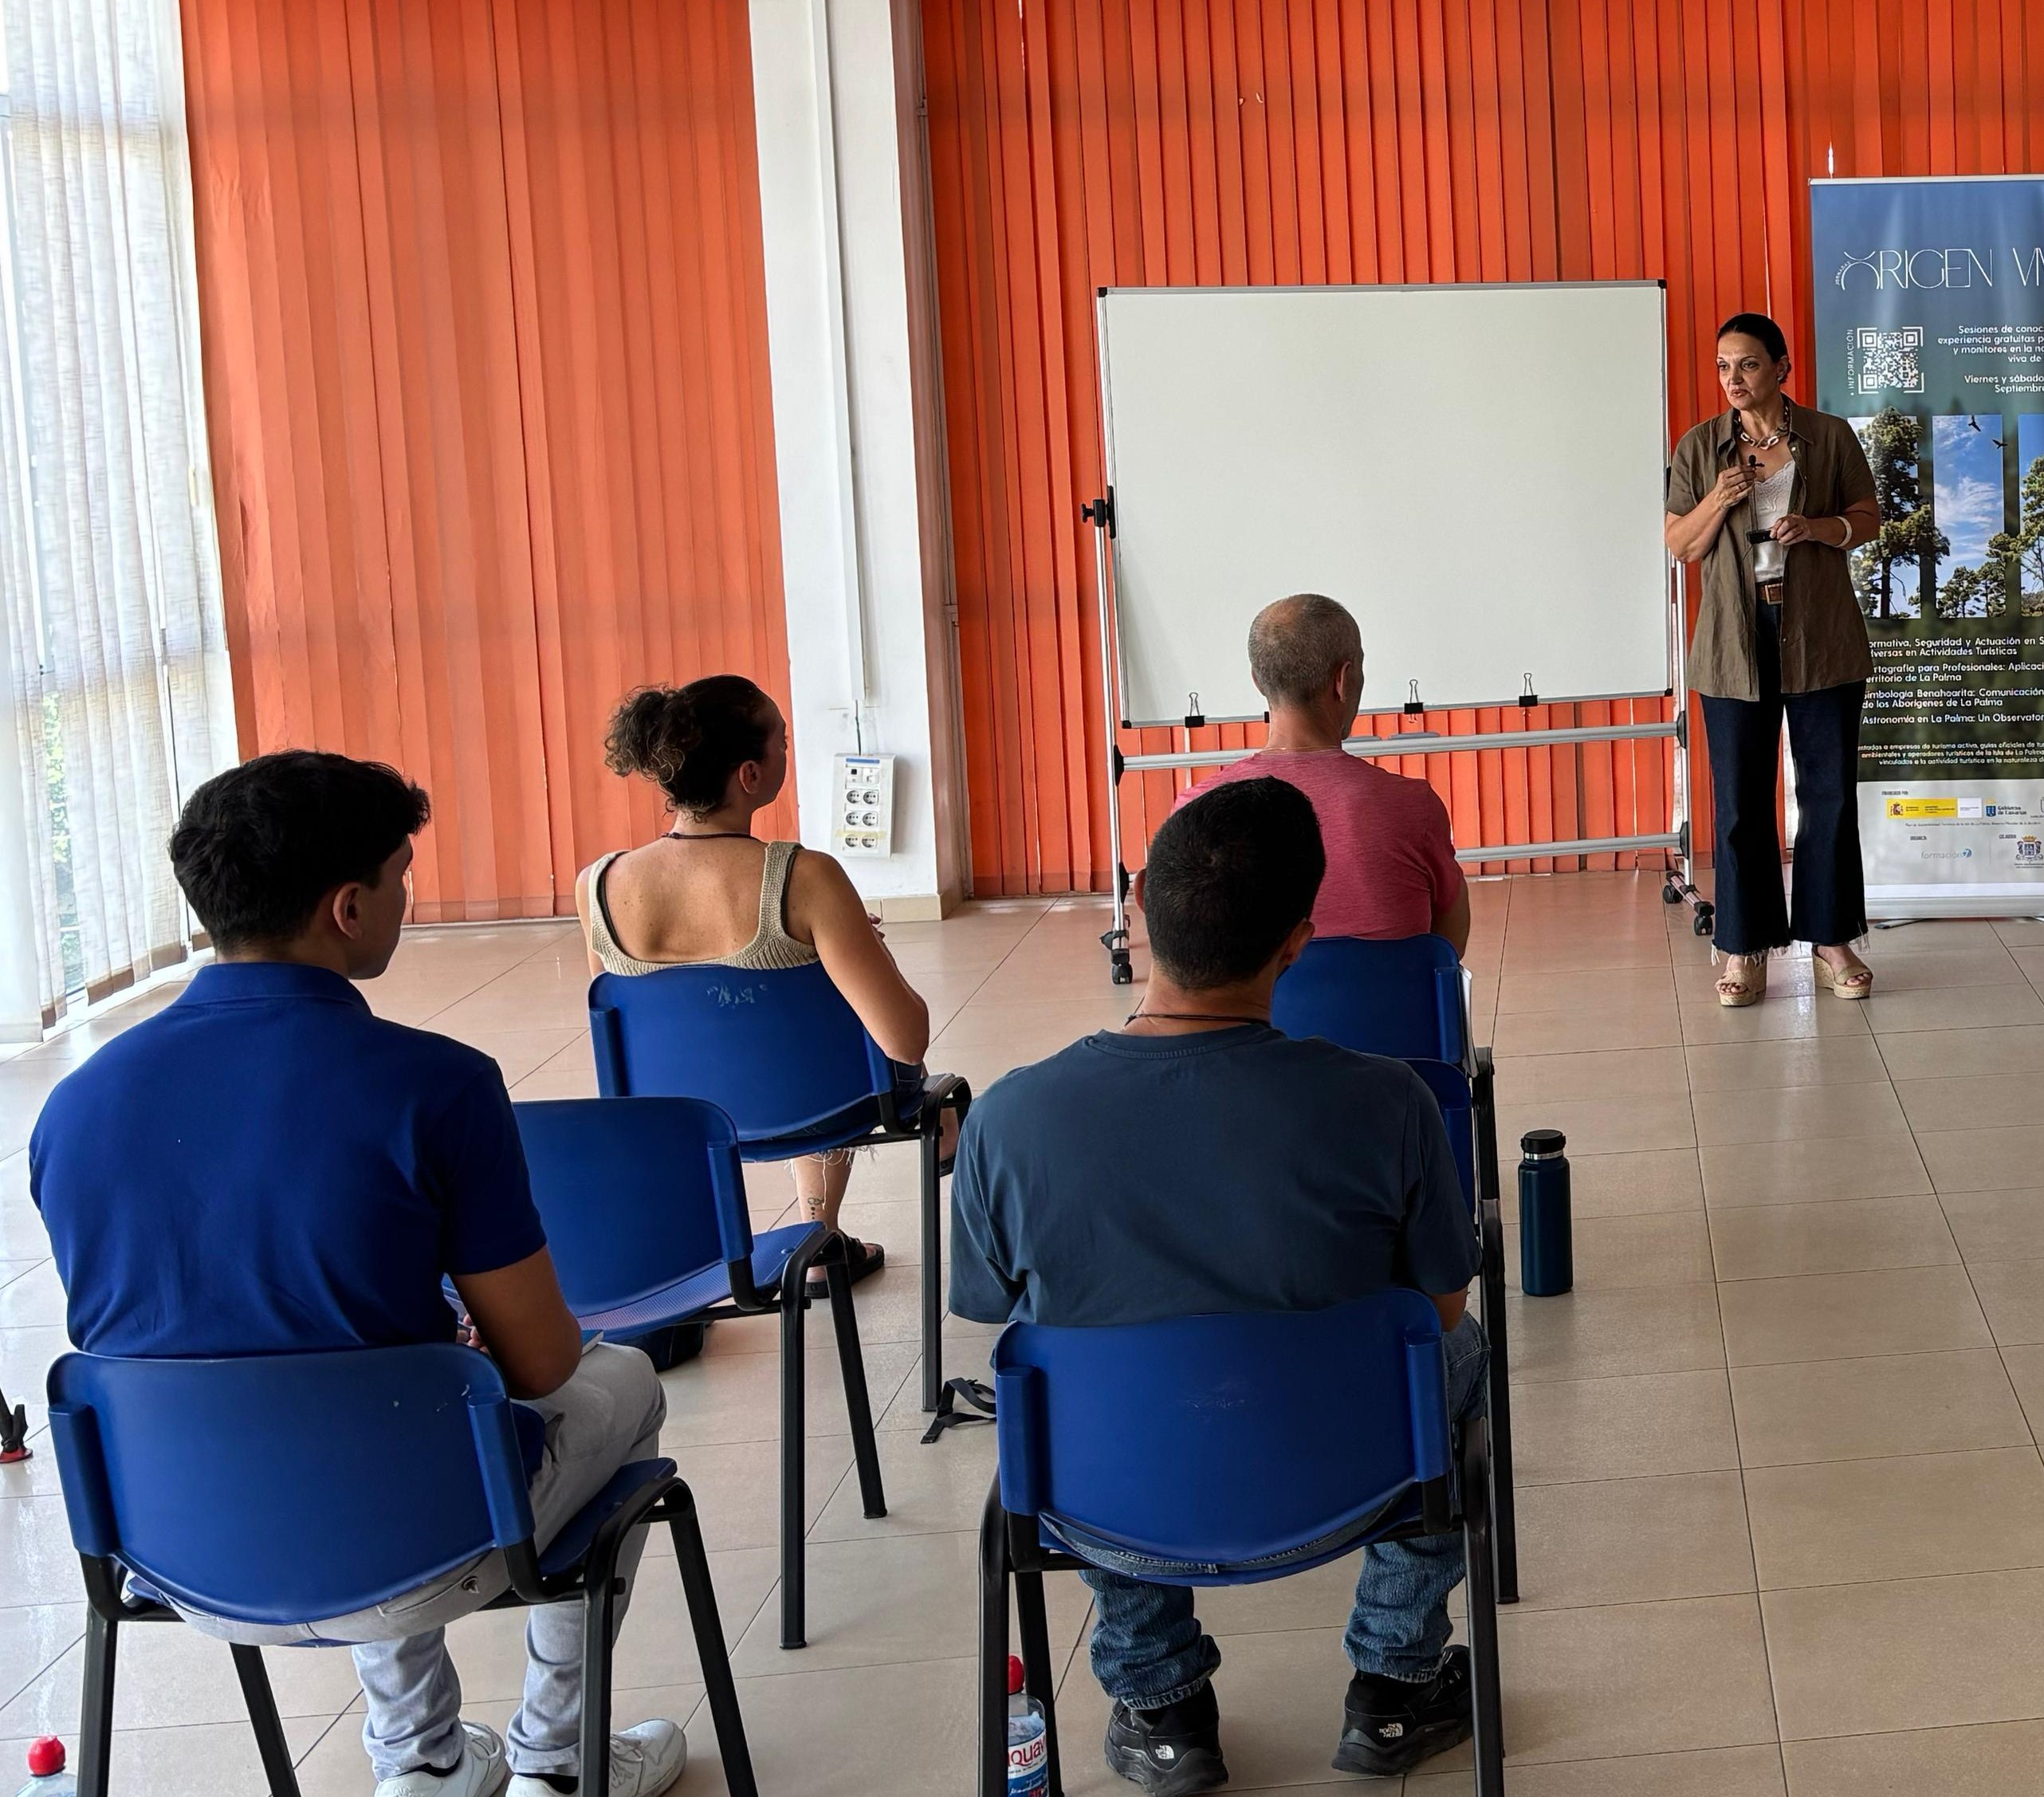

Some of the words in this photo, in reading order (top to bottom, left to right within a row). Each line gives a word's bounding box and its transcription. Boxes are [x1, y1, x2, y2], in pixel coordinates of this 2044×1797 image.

[2012, 246, 2044, 287] VI
[1958, 325, 1999, 334] Sesiones
[2001, 324, 2013, 333] de
[1937, 335, 1991, 345] experiencia
[1994, 335, 2035, 345] gratuitas
[2038, 336, 2044, 344] p
[2023, 344, 2032, 352] la
[2007, 354, 2027, 363] viva
[1963, 375, 1999, 383] Viernes
[2009, 373, 2044, 383] sábado
[1869, 639, 1912, 648] ormativa,
[1915, 638, 1962, 648] Seguridad
[1965, 639, 1971, 647] y
[1975, 636, 2021, 646] Actuación
[2039, 636, 2044, 645] S
[1919, 647, 1973, 656] Actividades
[1975, 647, 2018, 655] Turísticas
[1873, 663, 1915, 674] rtografía
[1917, 665, 1940, 674] para
[1942, 662, 2006, 672] Profesionales:
[2008, 661, 2044, 673] Aplicaci
[1865, 674, 1903, 683] erritorio
[1932, 673, 1962, 682] Palma
[1916, 688, 1975, 698] Benahoarita:
[1979, 686, 2044, 698] Comunicación
[1892, 699, 1944, 709] Aborígenes
[1946, 698, 1958, 707] de
[1974, 698, 2003, 706] Palma
[1861, 714, 1915, 725] Astronomía
[1931, 714, 1942, 723] La
[1944, 714, 1975, 722] Palma:
[1978, 714, 1991, 722] Un
[1992, 713, 2044, 722] Observator
